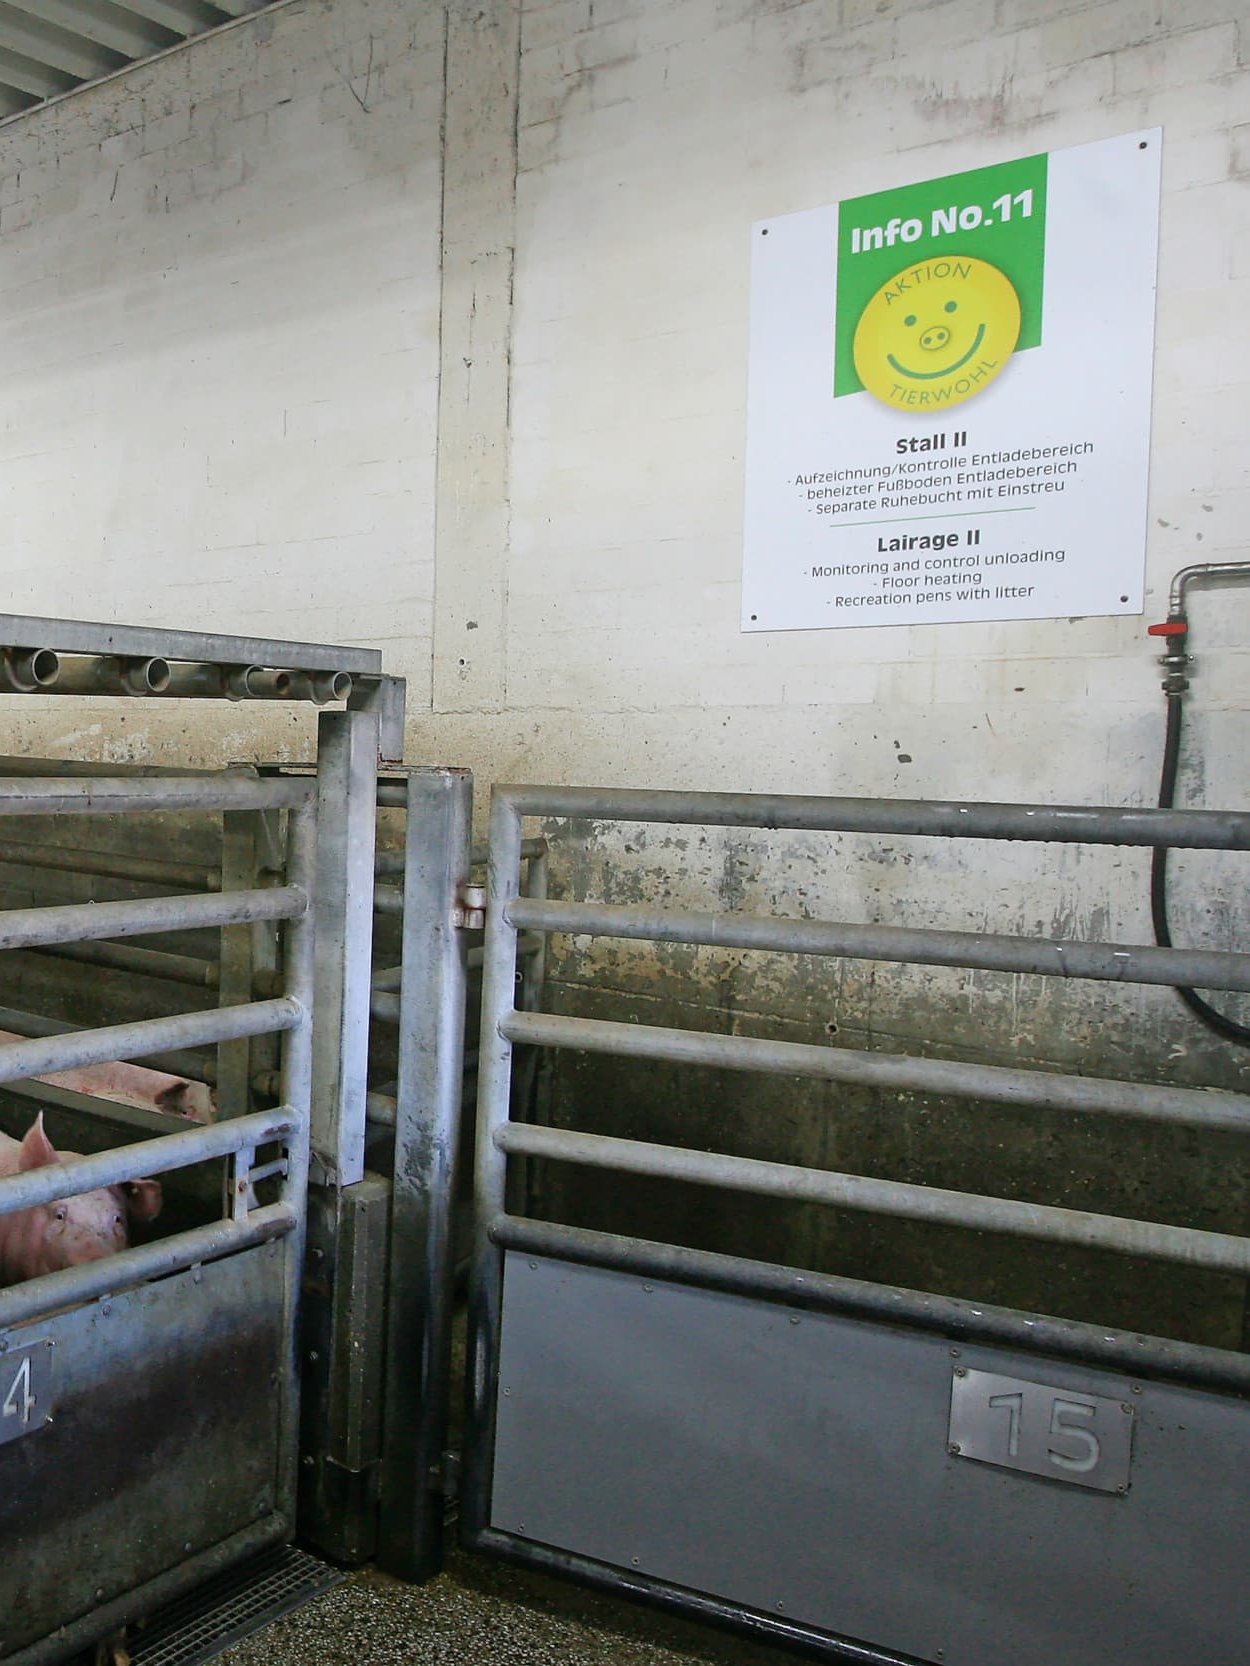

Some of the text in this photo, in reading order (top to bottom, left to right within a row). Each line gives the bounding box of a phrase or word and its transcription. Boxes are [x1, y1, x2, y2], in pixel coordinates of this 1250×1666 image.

[852, 188, 1033, 254] Info No.11
[884, 262, 972, 305] AKTION
[889, 359, 998, 405] TIERWOHL
[896, 431, 967, 454] Stall II
[795, 442, 1094, 486] Aufzeichnung/Kontrolle Entladebereich
[807, 460, 1077, 500] beheizter Fußboden Entladebereich
[816, 480, 1065, 515] Separate Ruhebucht mit Einstreu
[878, 529, 980, 553] Lairage II
[812, 550, 1065, 578] Monitoring and control unloading
[882, 571, 982, 589] Floor heating
[835, 585, 1035, 608] Recreation pens with litter
[988, 1393, 1100, 1473] 15
